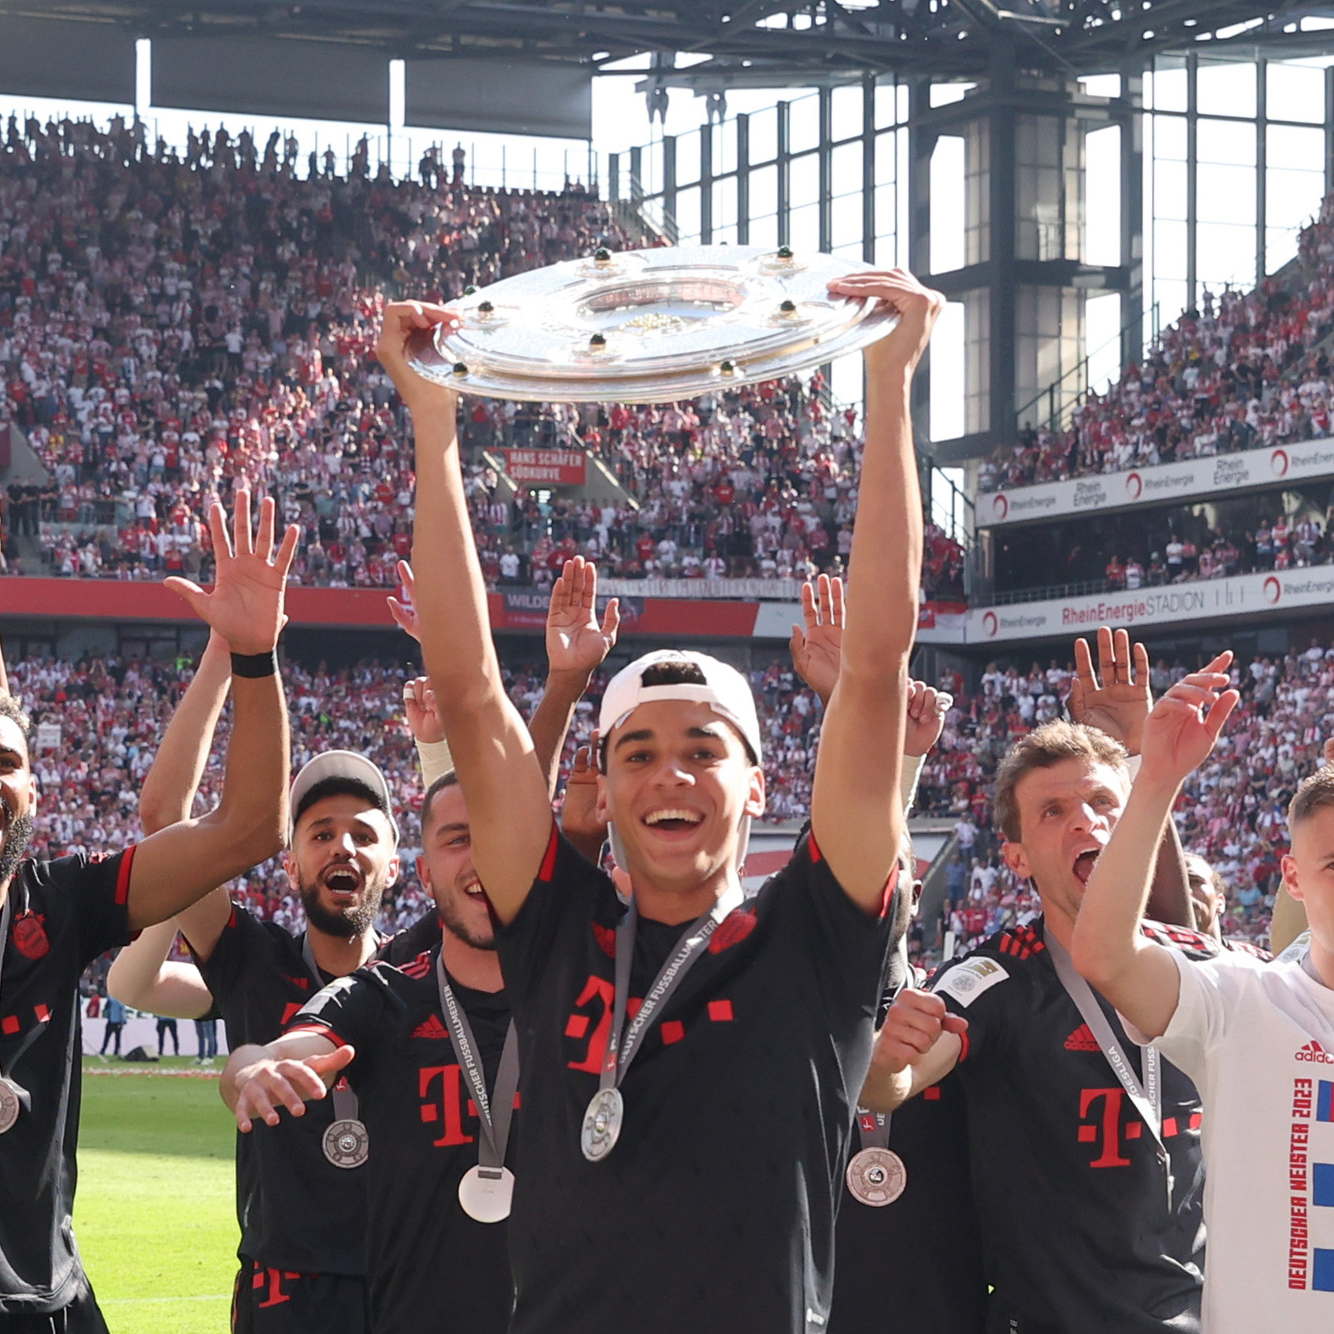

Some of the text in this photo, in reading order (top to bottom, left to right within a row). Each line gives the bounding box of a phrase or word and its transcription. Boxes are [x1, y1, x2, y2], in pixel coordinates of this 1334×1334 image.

[510, 451, 536, 464] HANS
[1108, 1045, 1141, 1099] DESLIGA
[1288, 1078, 1312, 1290] DEUTSCHER MEISTER 2023
